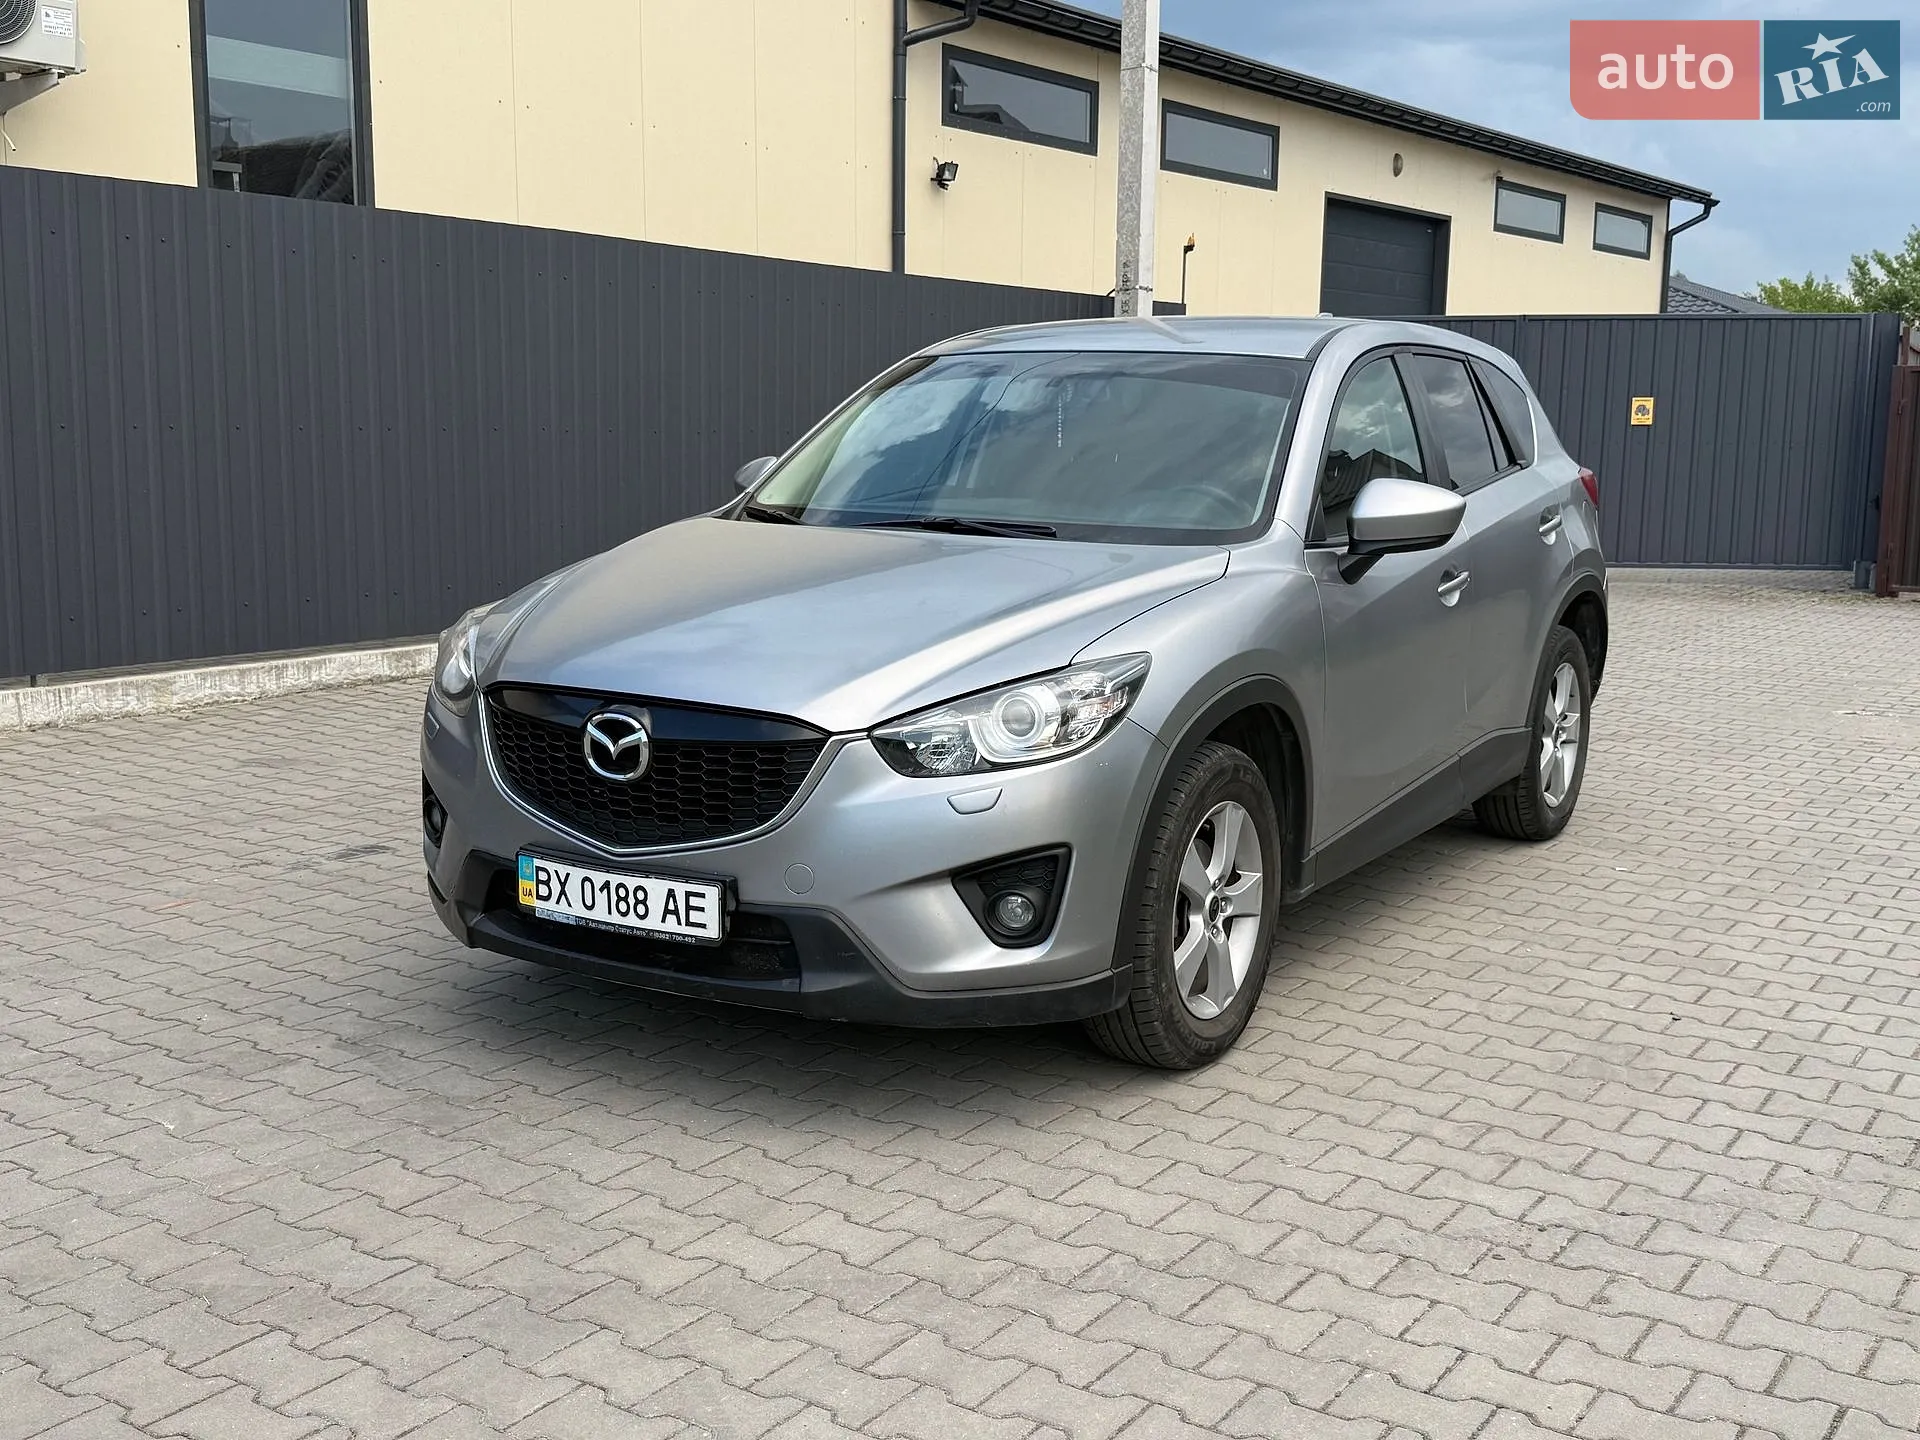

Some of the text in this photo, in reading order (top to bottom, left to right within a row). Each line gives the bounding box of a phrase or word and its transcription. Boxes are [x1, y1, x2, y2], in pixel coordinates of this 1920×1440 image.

[522, 886, 533, 898] UA
[535, 866, 572, 908] BX
[580, 876, 649, 920] 0188
[661, 888, 707, 929] AE
